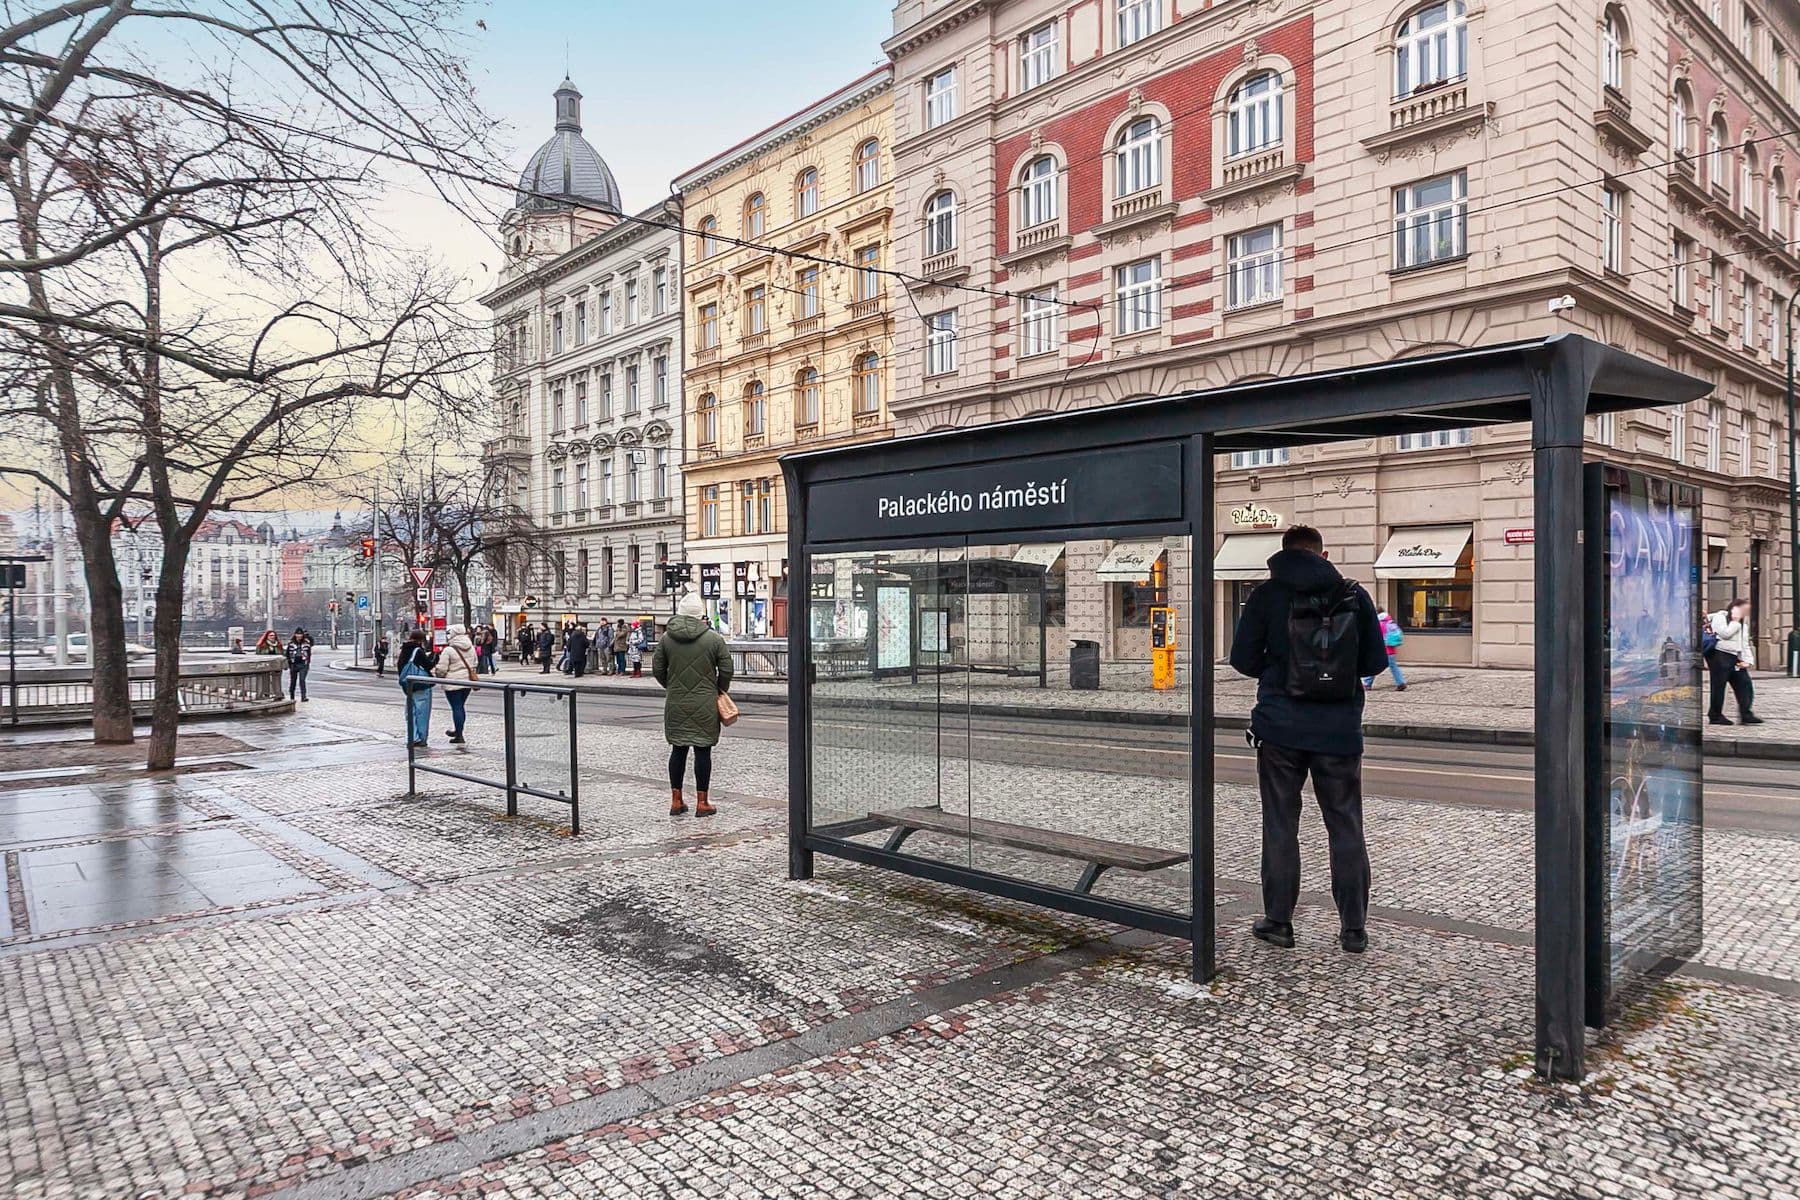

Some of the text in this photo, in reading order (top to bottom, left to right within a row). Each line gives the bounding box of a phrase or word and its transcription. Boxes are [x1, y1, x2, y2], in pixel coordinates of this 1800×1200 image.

[878, 478, 1068, 518] Palackého náměstí
[1232, 509, 1278, 527] Black Dog
[1398, 548, 1442, 559] Black Dog
